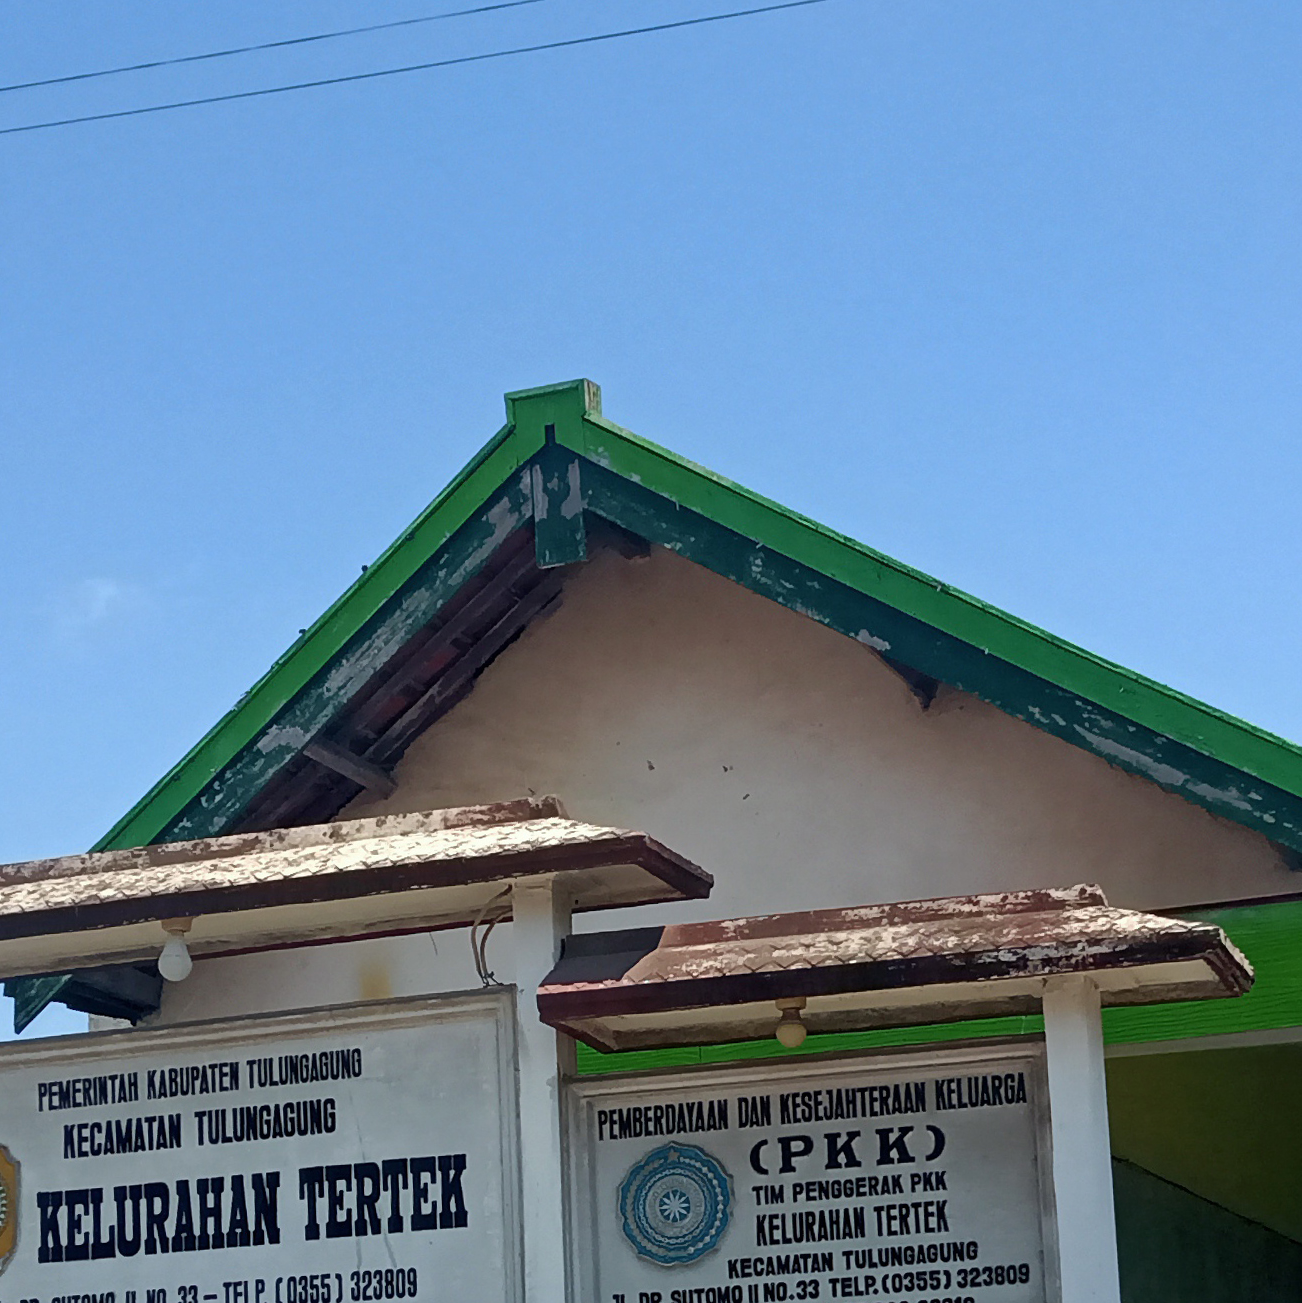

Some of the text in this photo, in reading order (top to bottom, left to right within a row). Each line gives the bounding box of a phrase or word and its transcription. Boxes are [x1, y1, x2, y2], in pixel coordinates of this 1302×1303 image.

[37, 1048, 362, 1112] PEMERINTAH KABUPATEN TULUNGAGUNG
[63, 1098, 336, 1159] KECAMATAN TULUNGAGUNG
[598, 1072, 1028, 1141] PEMBERDAYAAN DAN KESEJAHTERAAN KELUARGA
[749, 1124, 945, 1175] (PKK)
[37, 1154, 467, 1263] KELURAHAN TERTEK
[752, 1171, 947, 1206] TIM PENGGERAK PKK
[756, 1200, 949, 1247] KELURAHAN TERTEK
[350, 1268, 417, 1301] 323809
[727, 1241, 978, 1279] KECAMATAN TULUNGAGUNG
[957, 1264, 1030, 1289] 323809
